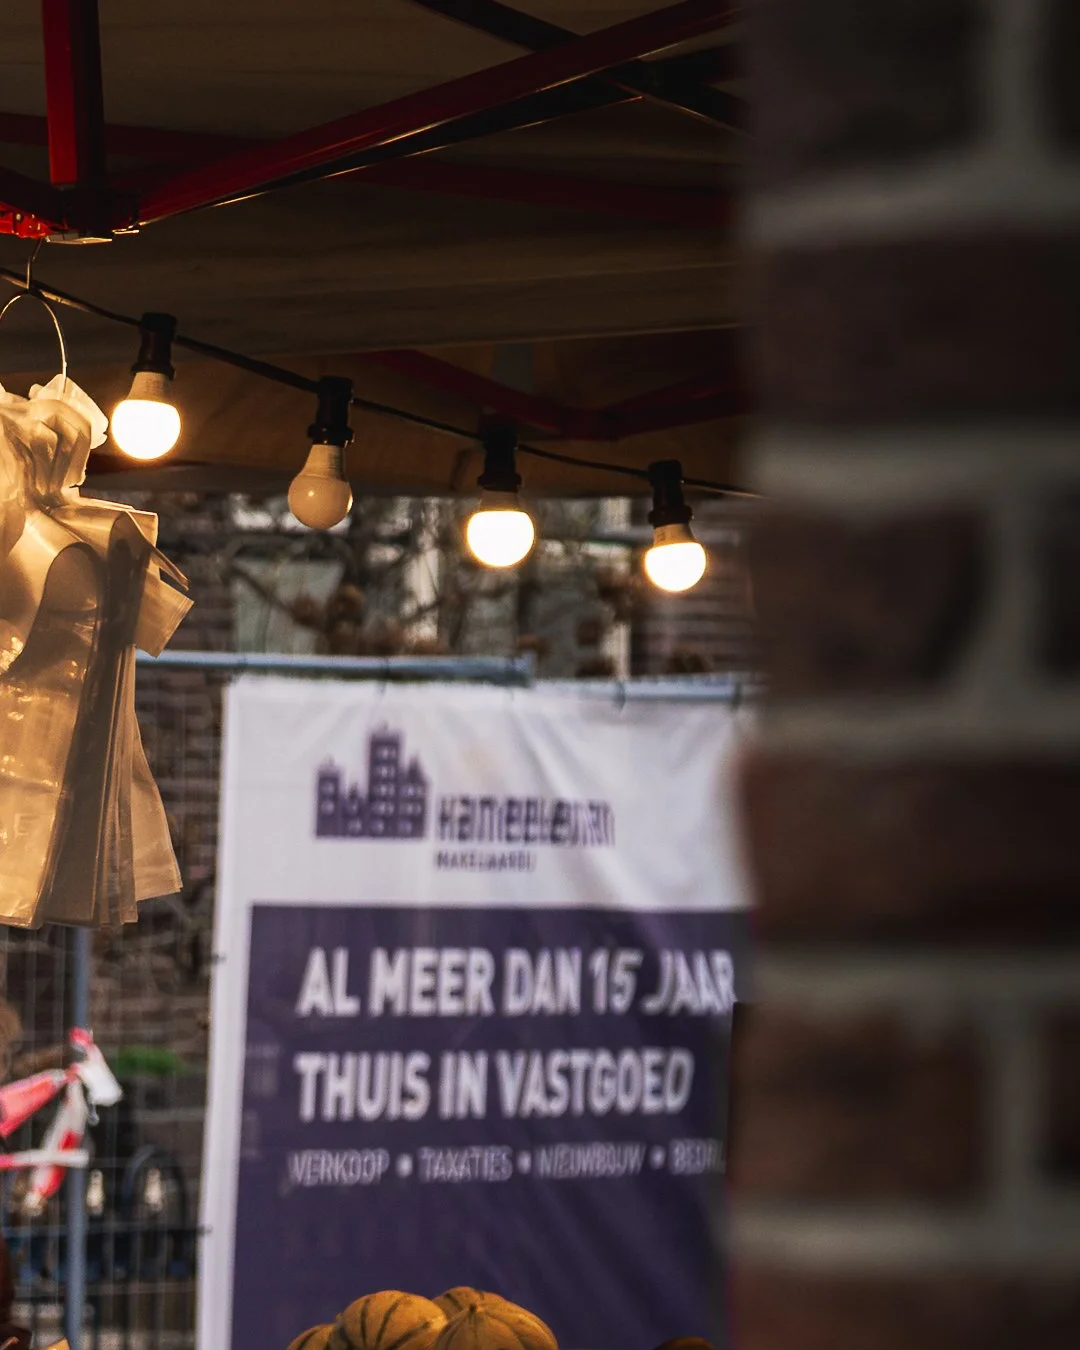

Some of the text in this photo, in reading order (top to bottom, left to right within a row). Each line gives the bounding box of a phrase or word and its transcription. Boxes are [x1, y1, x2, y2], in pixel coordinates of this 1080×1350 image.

[296, 946, 737, 1017] AL MEER DAN 15 JAAR
[293, 1046, 695, 1123] THUIS IN VASTGOED
[288, 1149, 390, 1186] VERKOOP
[419, 1145, 513, 1183] TAXATIES
[535, 1141, 648, 1179] NIEUWBOUW
